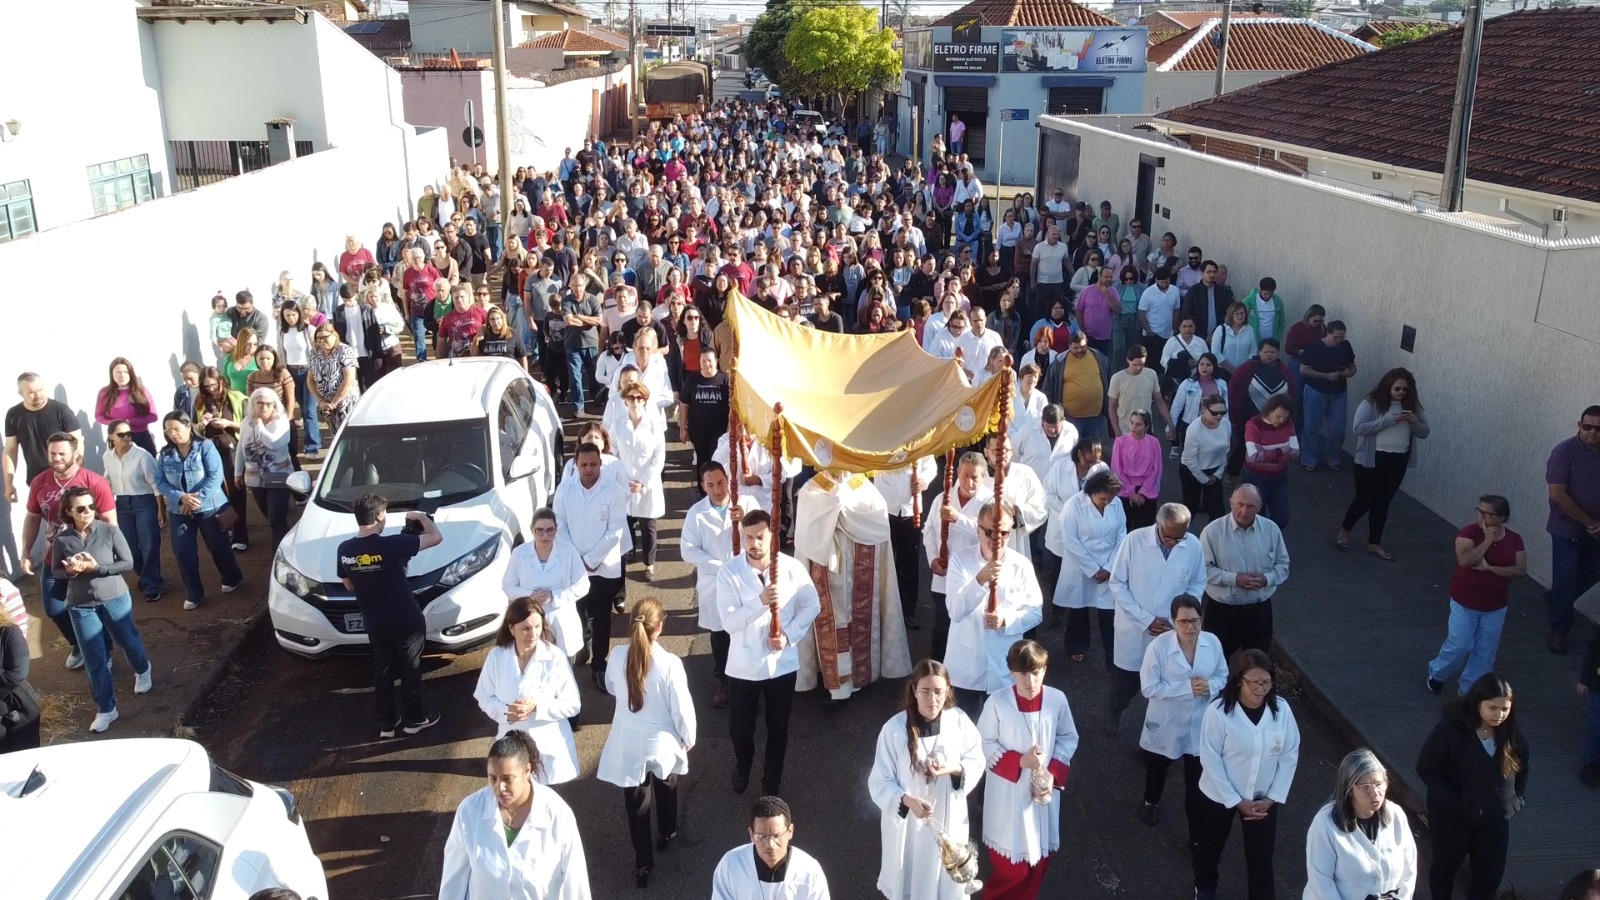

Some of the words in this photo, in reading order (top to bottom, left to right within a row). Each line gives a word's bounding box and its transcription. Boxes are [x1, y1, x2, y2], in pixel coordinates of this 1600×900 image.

[934, 45, 967, 55] ELETRO
[969, 45, 998, 55] FIRME
[1095, 57, 1115, 65] ELETRO
[1116, 57, 1133, 65] FIRME
[483, 344, 507, 353] AMAR
[695, 390, 722, 400] AMAR
